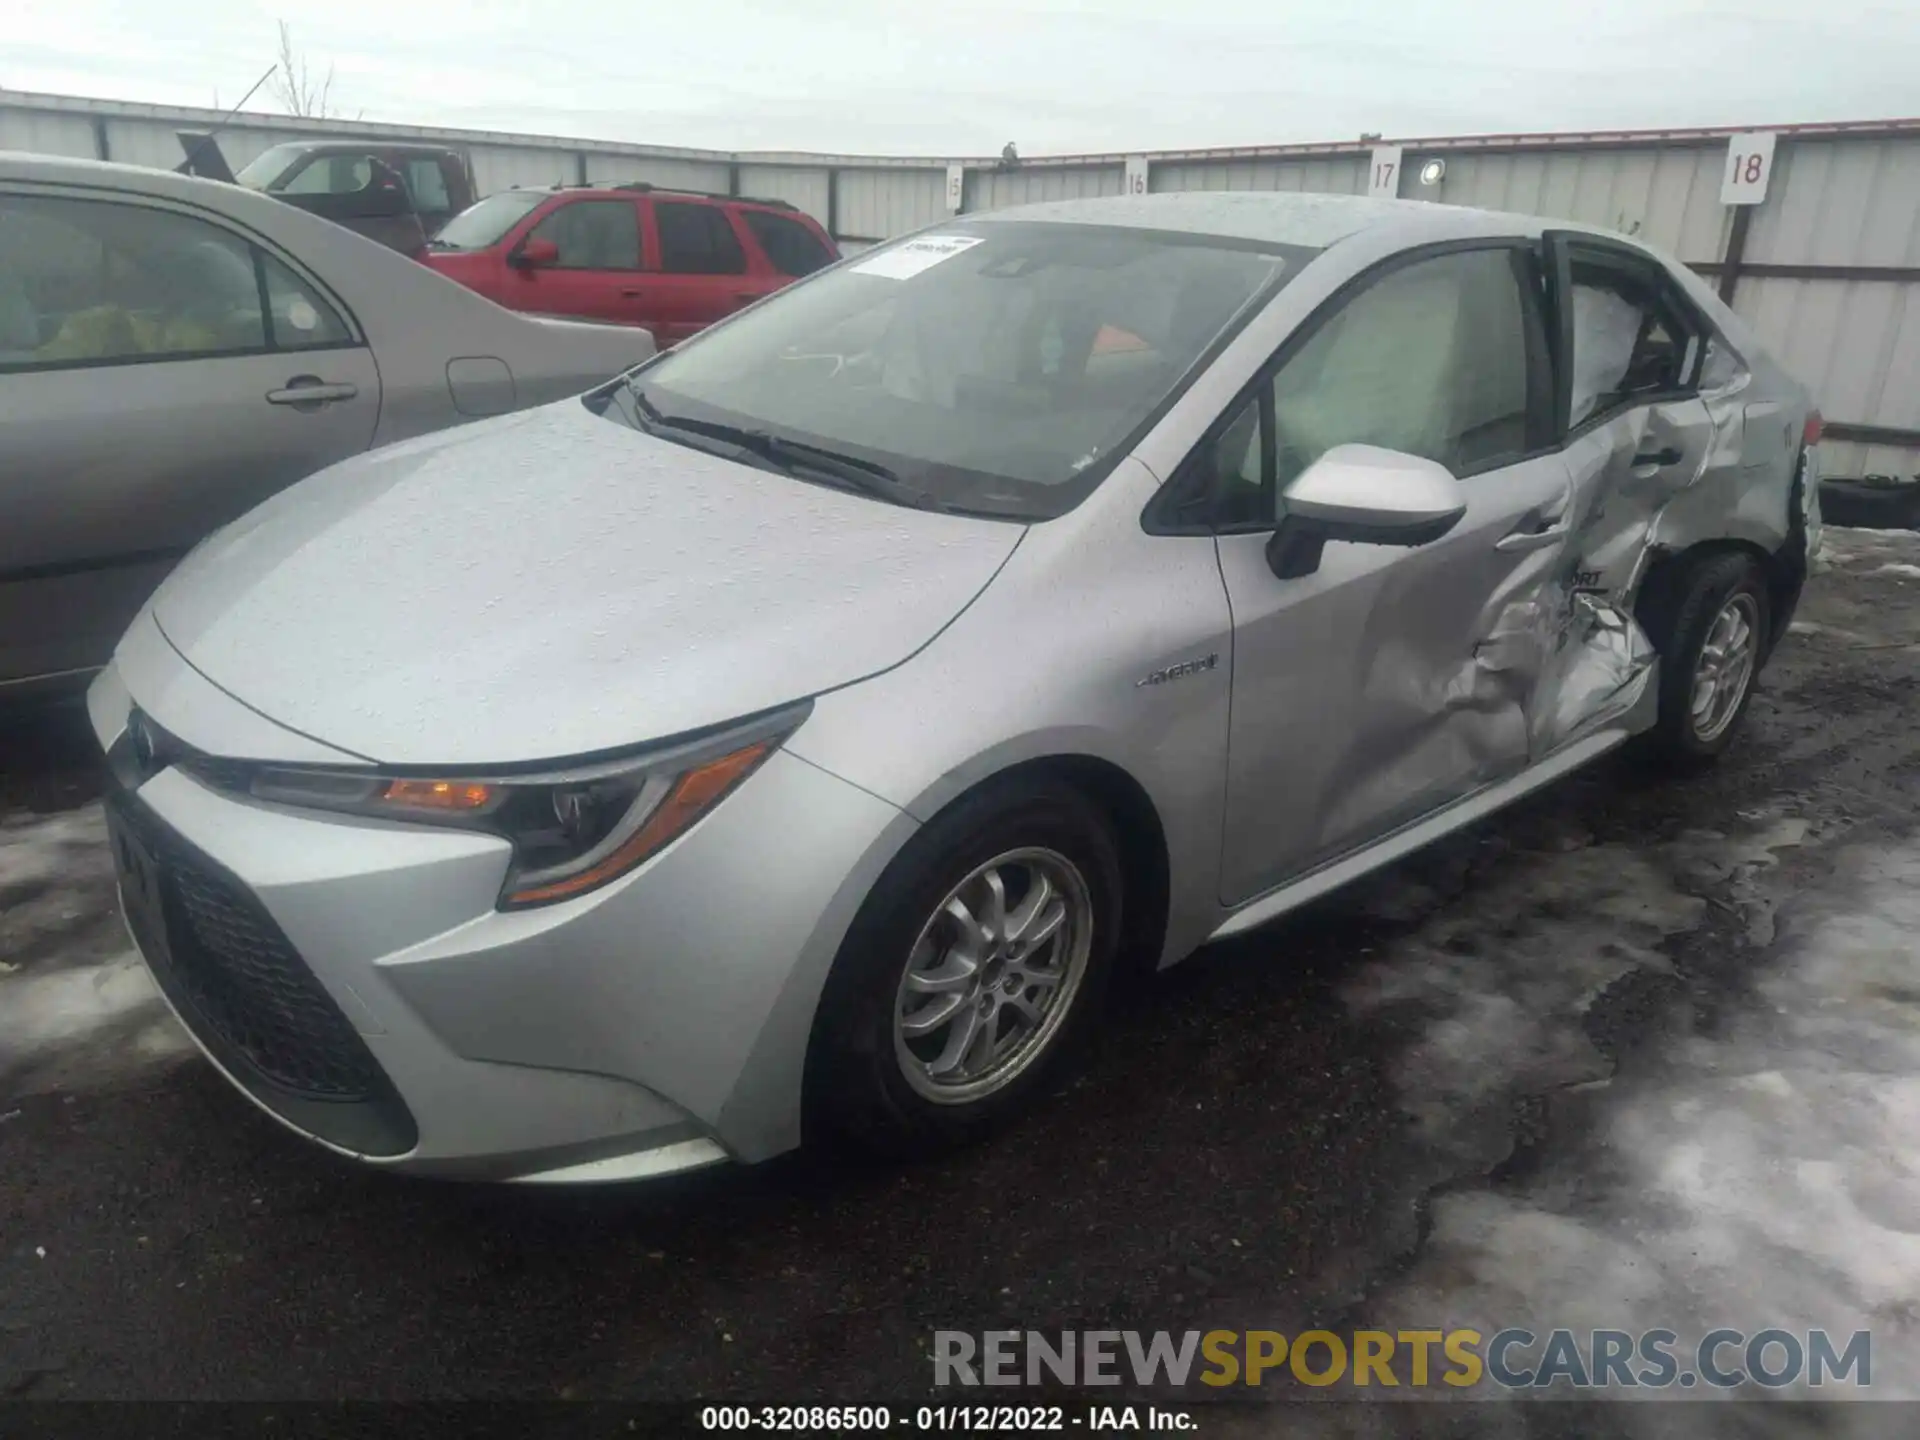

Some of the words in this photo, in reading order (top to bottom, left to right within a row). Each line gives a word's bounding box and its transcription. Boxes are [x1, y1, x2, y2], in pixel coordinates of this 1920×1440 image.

[1375, 163, 1395, 189] 17
[1732, 153, 1763, 184] 18
[1130, 174, 1144, 195] 16
